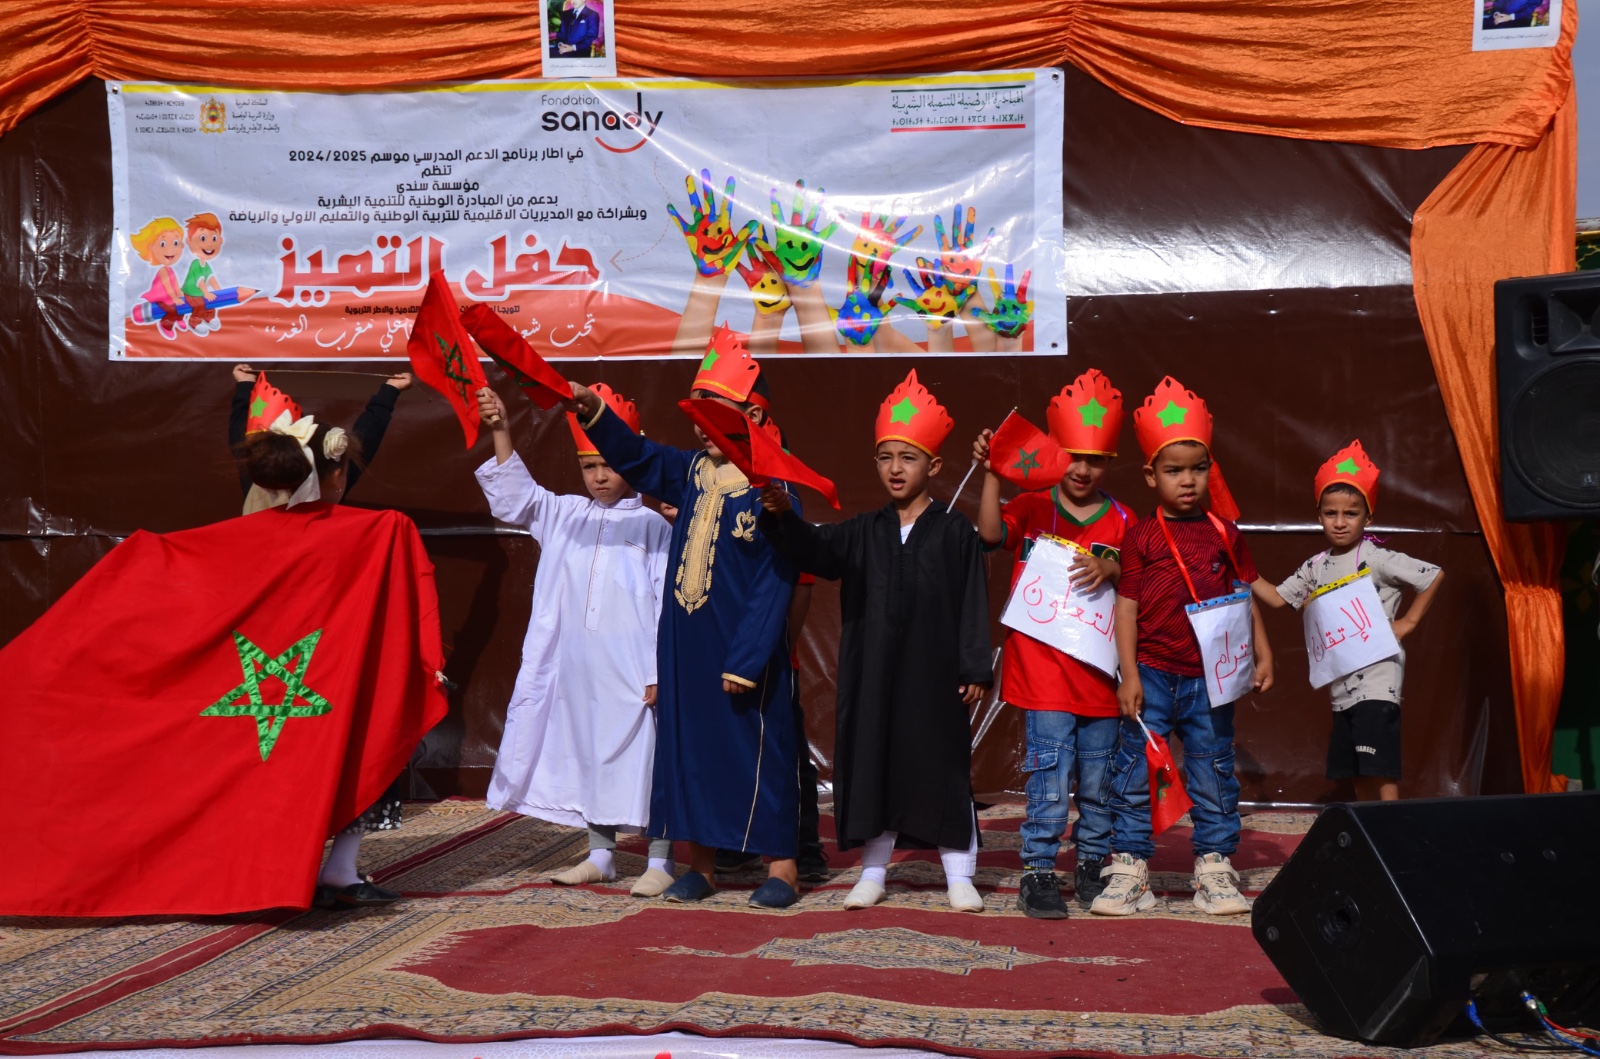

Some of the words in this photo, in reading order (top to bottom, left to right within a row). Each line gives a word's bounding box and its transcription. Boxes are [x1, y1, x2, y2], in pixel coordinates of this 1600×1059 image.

[541, 95, 600, 106] Fondation
[541, 92, 664, 137] sanady
[289, 150, 367, 162] 2024/2025
[370, 151, 410, 164] موسم
[413, 149, 462, 166] المدرسي
[465, 149, 499, 162] الدعم
[502, 148, 538, 162] برنامج
[541, 148, 563, 161] اطار
[567, 147, 584, 163] في
[421, 165, 452, 178] تنظم
[432, 178, 480, 193] مؤسسة
[318, 194, 361, 209] البشرية
[364, 195, 405, 208] للتنمية
[408, 194, 453, 208] الوطنية
[457, 194, 503, 207] المبادرة
[506, 194, 524, 205] من
[527, 195, 558, 207] بدعم
[229, 210, 279, 224] والرياضة
[319, 210, 370, 223] والتعليم
[373, 210, 419, 223] الوطنية
[422, 210, 460, 223] للتربية
[463, 208, 516, 222] الاقليمية
[519, 208, 573, 222] المديريات
[576, 209, 594, 222] مع
[597, 205, 648, 221] وبشراكة
[273, 234, 446, 303] التميز
[464, 233, 600, 297] حفل
[344, 305, 372, 315] التربوية
[497, 305, 520, 315] تتويجا
[314, 317, 375, 351] مغرب
[512, 317, 541, 339] شعا
[549, 313, 596, 347] تحت
[1022, 575, 1116, 642] التعاون
